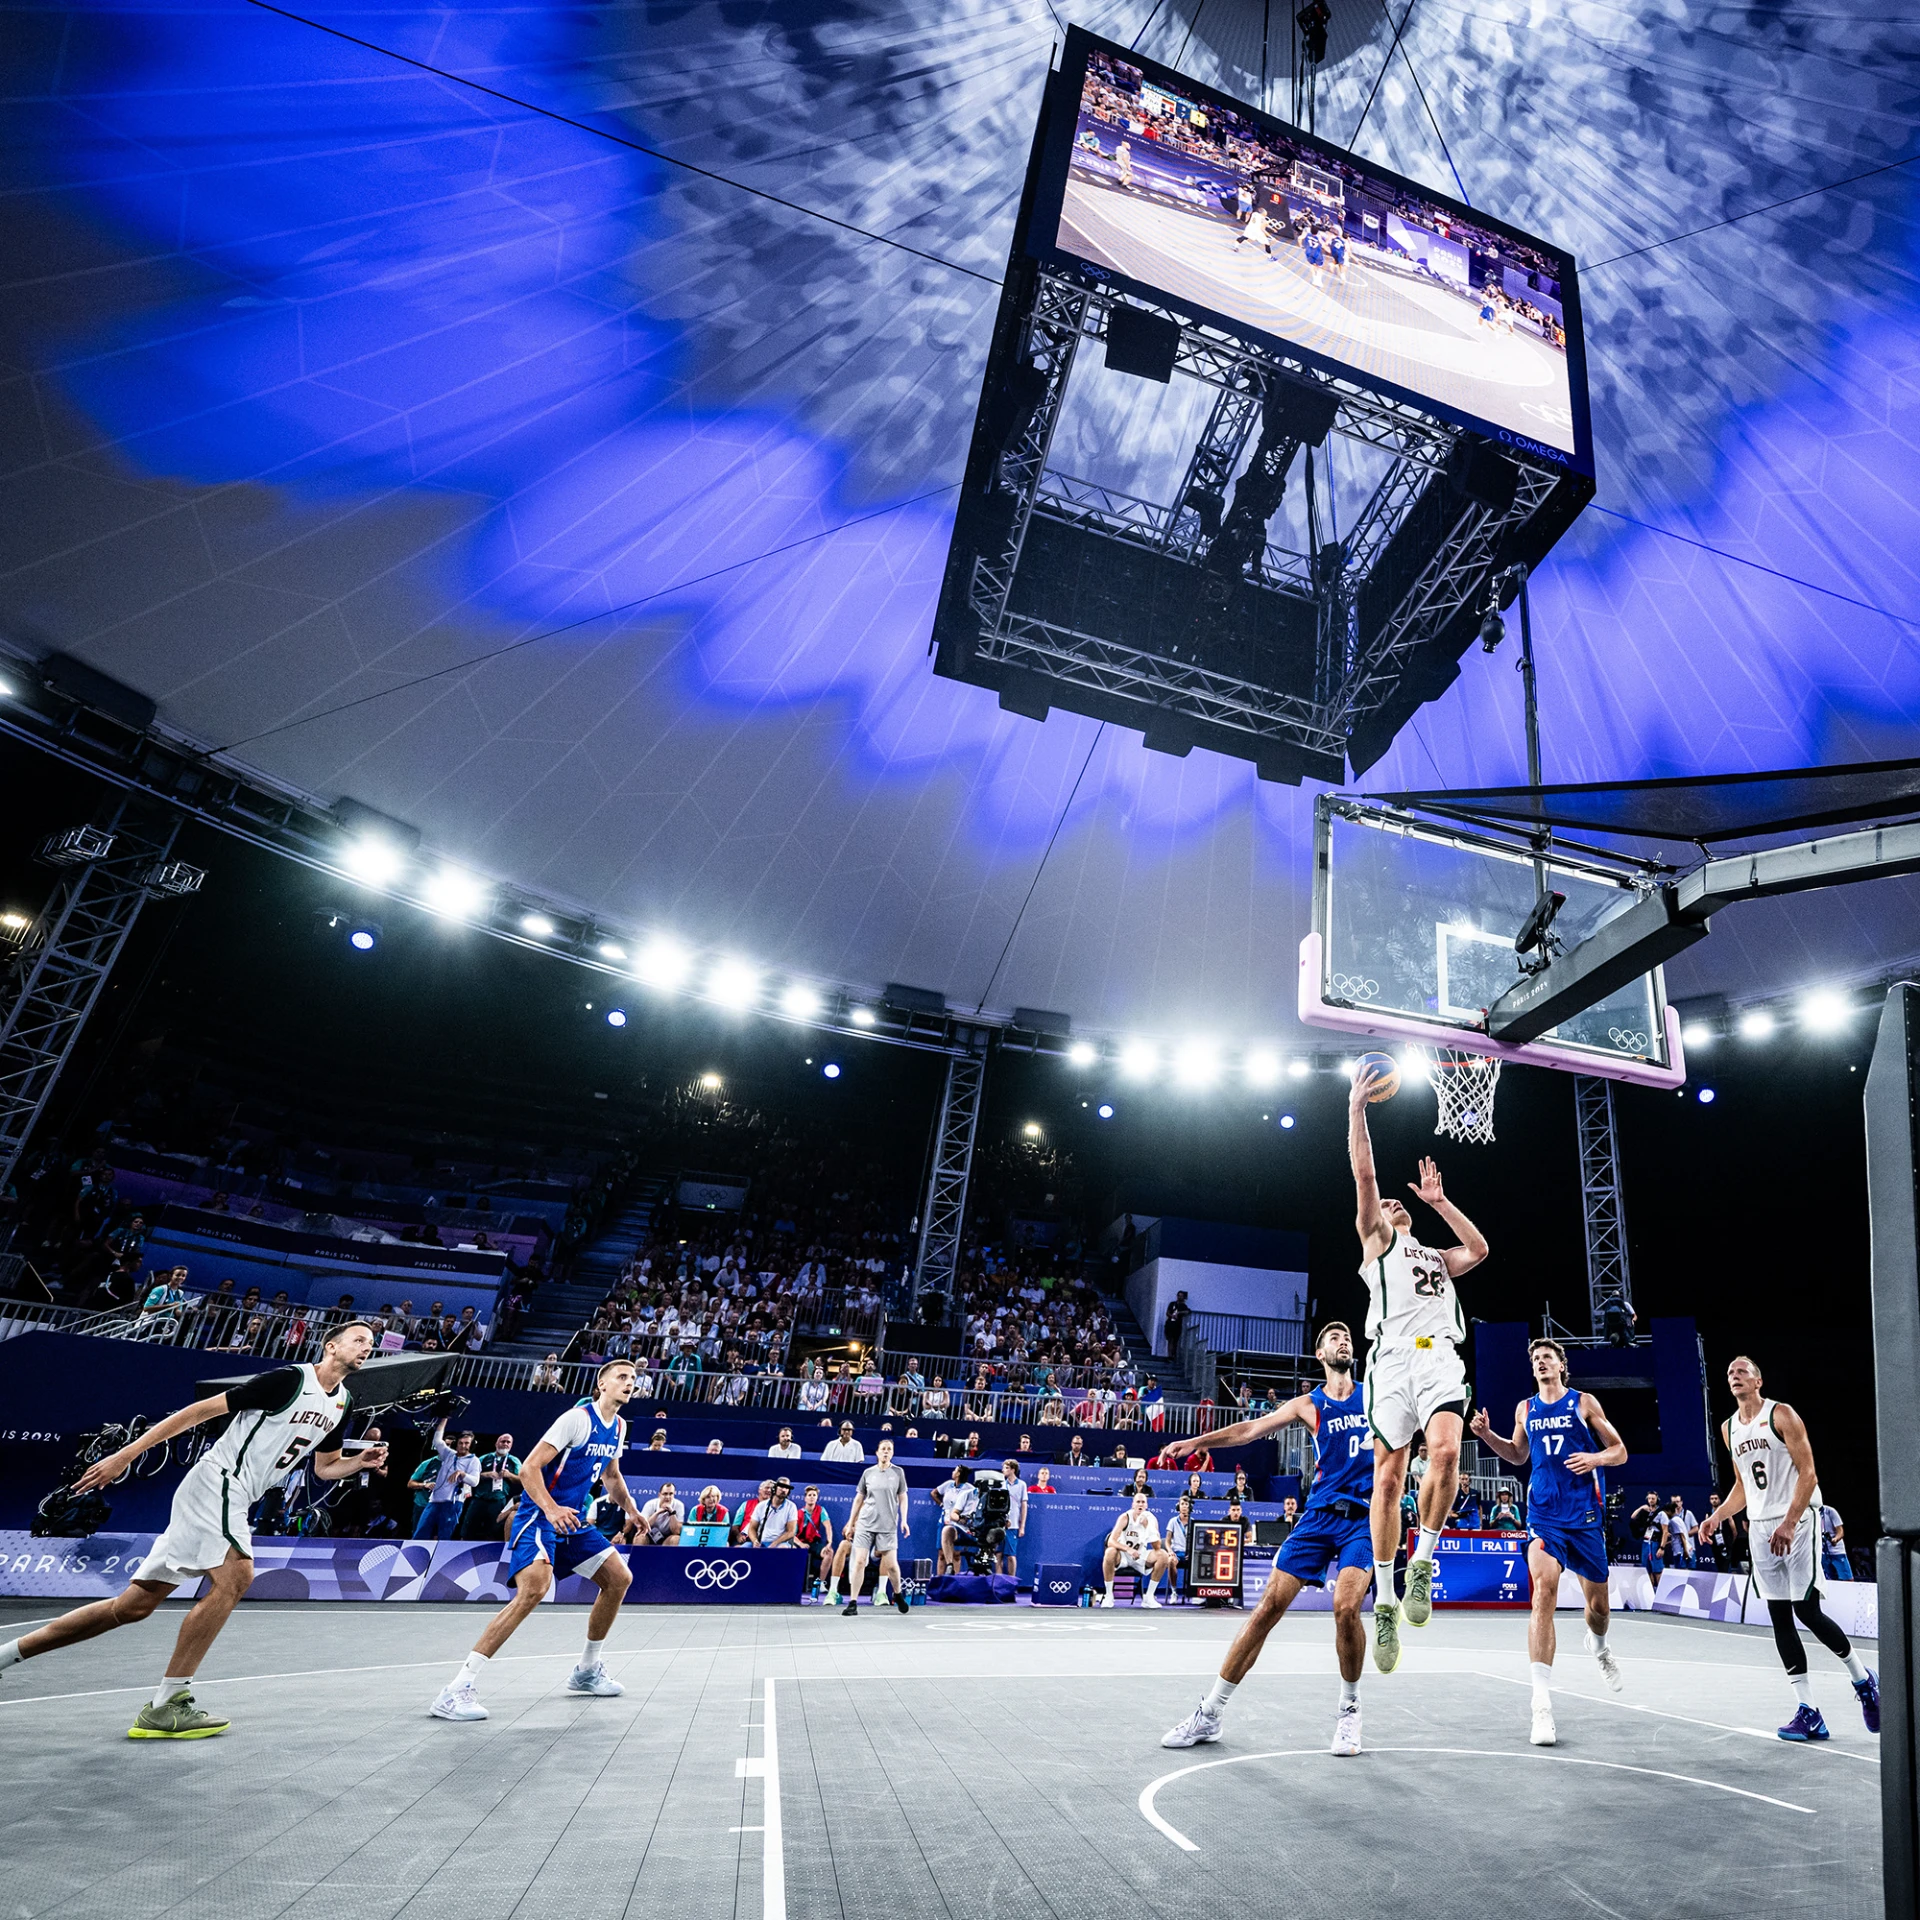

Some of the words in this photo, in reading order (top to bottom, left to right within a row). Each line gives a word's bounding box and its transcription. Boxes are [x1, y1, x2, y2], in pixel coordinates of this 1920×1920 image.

[1515, 436, 1569, 465] OMEGA
[1512, 992, 1530, 1009] PARIS
[196, 1227, 219, 1237] PARIS
[221, 1232, 242, 1242] 2024
[314, 1249, 338, 1259] PARIS
[339, 1252, 360, 1261] 2024
[414, 1260, 436, 1268] PARIS
[437, 1262, 457, 1270] 2024
[1327, 1414, 1368, 1434] FRANC
[1530, 1415, 1573, 1432] FRANCE
[20, 1430, 61, 1442] 2024
[275, 1436, 312, 1470] 5
[585, 1443, 617, 1458] FRANCE
[1349, 1436, 1360, 1458] 0
[1541, 1434, 1565, 1456] 17
[1735, 1438, 1772, 1458] LIETUVA
[590, 1462, 603, 1483] 3
[1751, 1460, 1768, 1490] 6
[1205, 1529, 1239, 1548] 7:15
[1506, 1531, 1527, 1539] OMEGA
[1442, 1540, 1460, 1550] LTU
[1482, 1541, 1503, 1551] FRA
[100, 1555, 147, 1574] 20
[1216, 1551, 1235, 1580] 8
[1699, 1556, 1716, 1564] 202
[1503, 1560, 1515, 1578] 7
[1206, 1588, 1231, 1596] OMEGA
[1432, 1590, 1439, 1599] 4
[1507, 1591, 1514, 1599] 4
